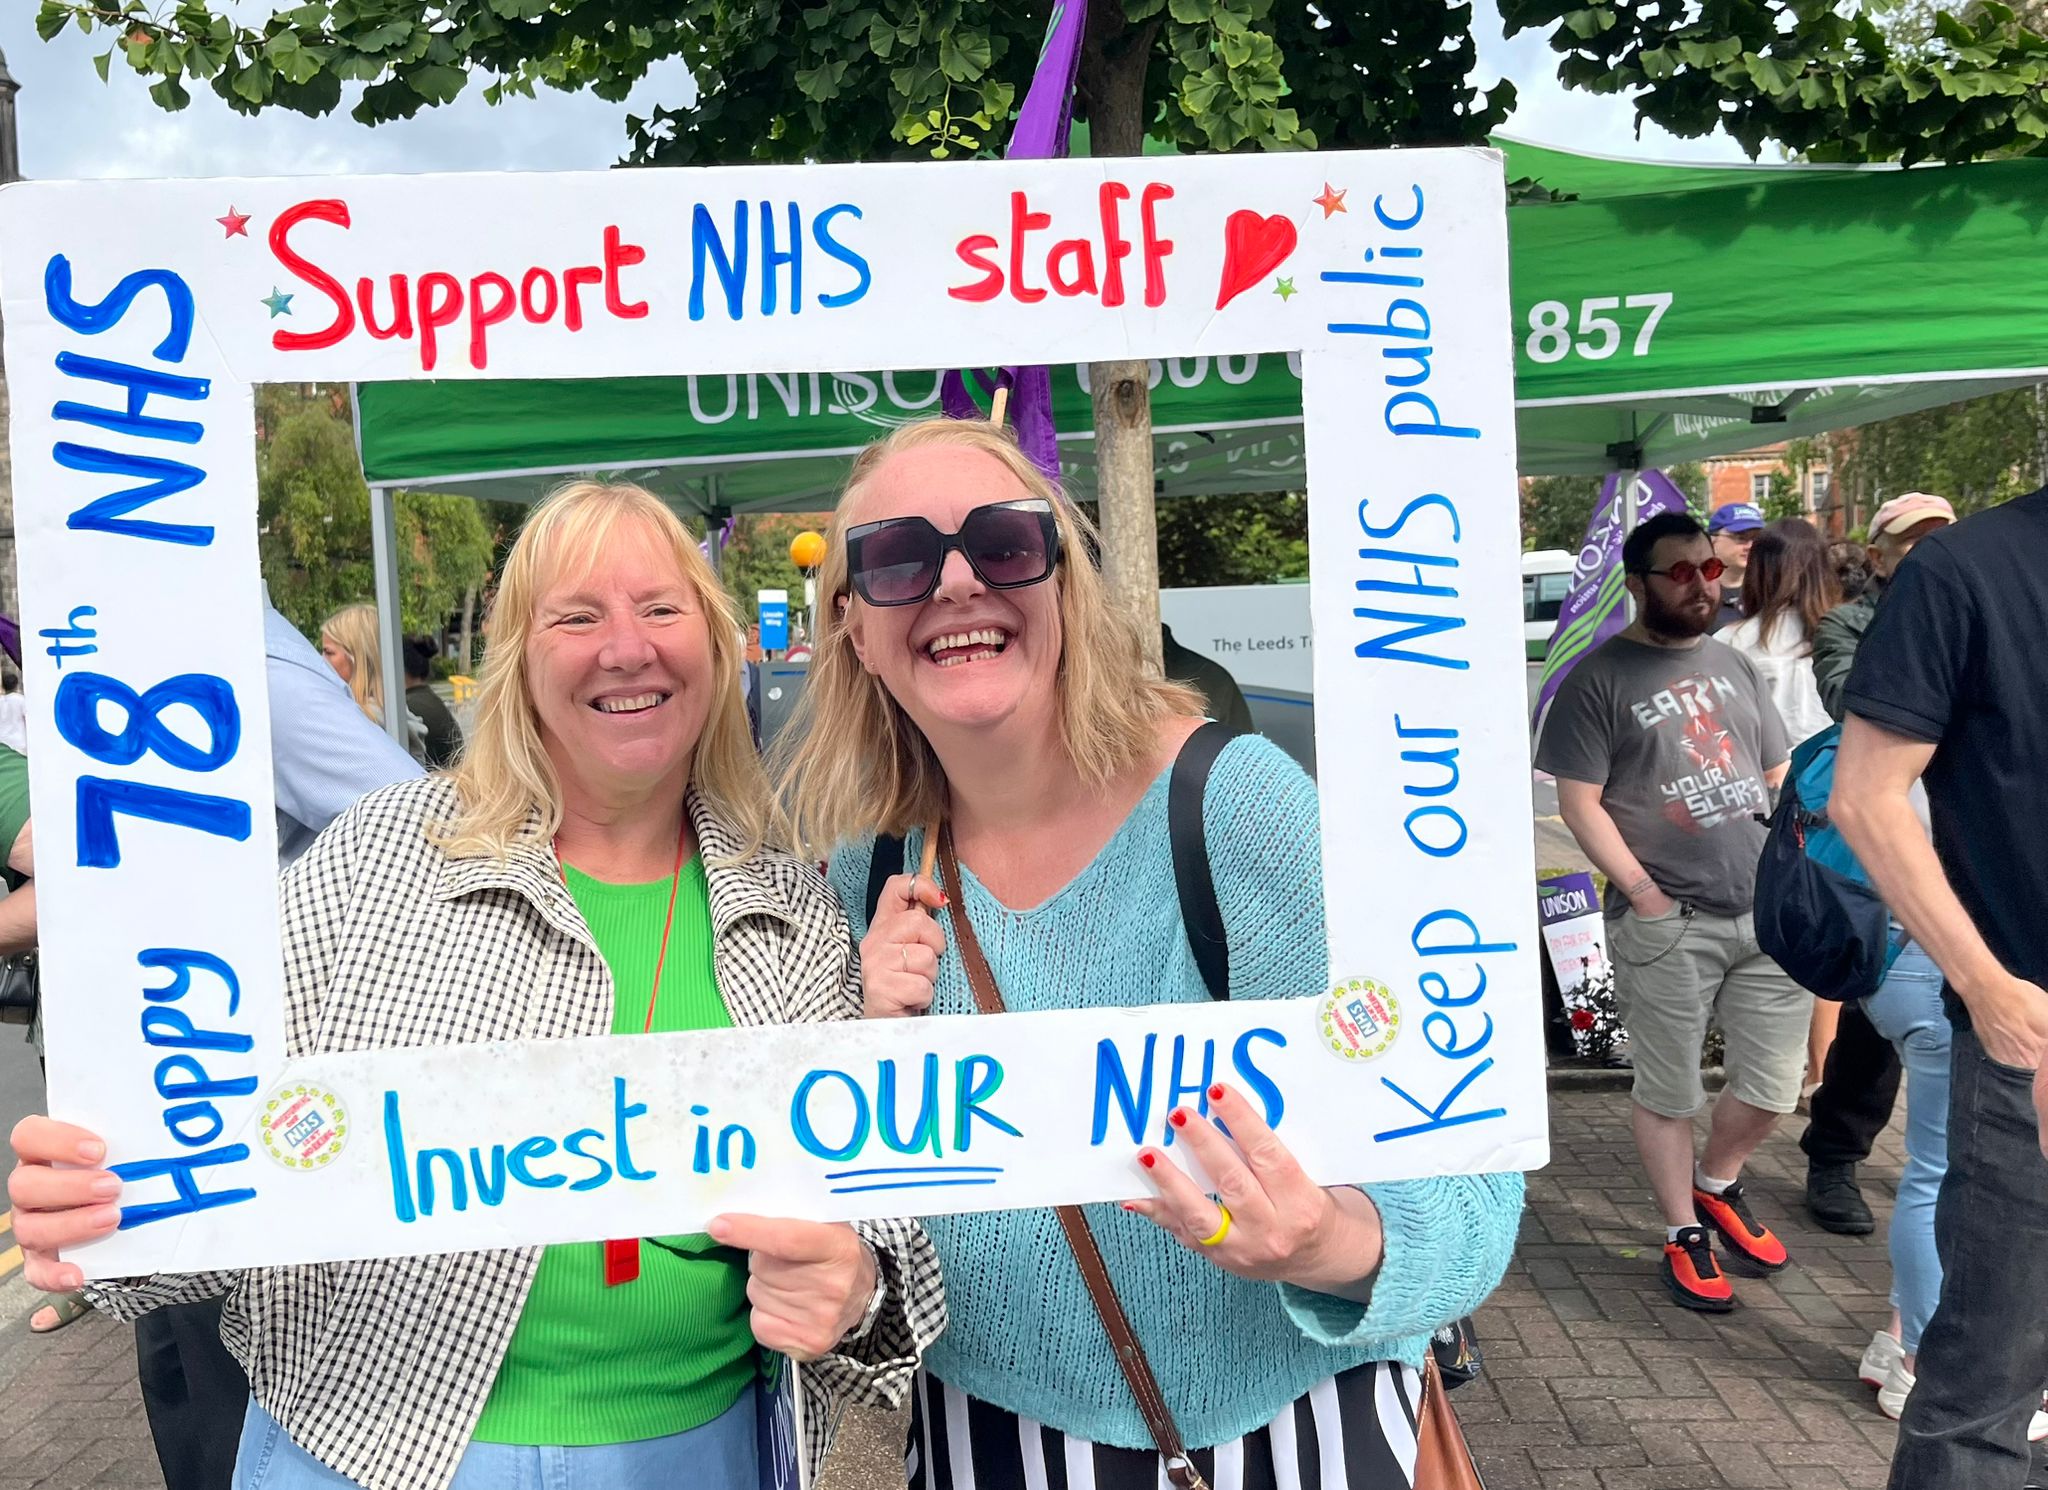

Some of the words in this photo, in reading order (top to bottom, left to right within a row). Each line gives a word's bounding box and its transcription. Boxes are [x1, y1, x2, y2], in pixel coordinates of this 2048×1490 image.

[268, 199, 649, 371] Support
[688, 199, 872, 322] NHS
[947, 181, 1175, 308] staff
[1320, 184, 1482, 439] public
[44, 253, 214, 547] NHS
[687, 369, 946, 425] UNISO
[1525, 292, 1673, 364] 857
[1212, 638, 1242, 652] The
[1247, 635, 1294, 651] Leeds
[1353, 493, 1471, 671] NHS
[1630, 673, 1738, 730] EARN
[1394, 713, 1468, 858] our
[1660, 767, 1727, 803] YOUR
[1684, 775, 1763, 818] SCARS
[1541, 888, 1588, 918] UNISON
[108, 947, 259, 1231] Happy
[1349, 1003, 1378, 1038] NHS
[1373, 908, 1518, 1143] Keep
[286, 1113, 320, 1146] NHS
[383, 1076, 657, 1224] Invest
[689, 1104, 757, 1175] in
[790, 1052, 1023, 1163] OUR
[1090, 1027, 1288, 1148] NHS
